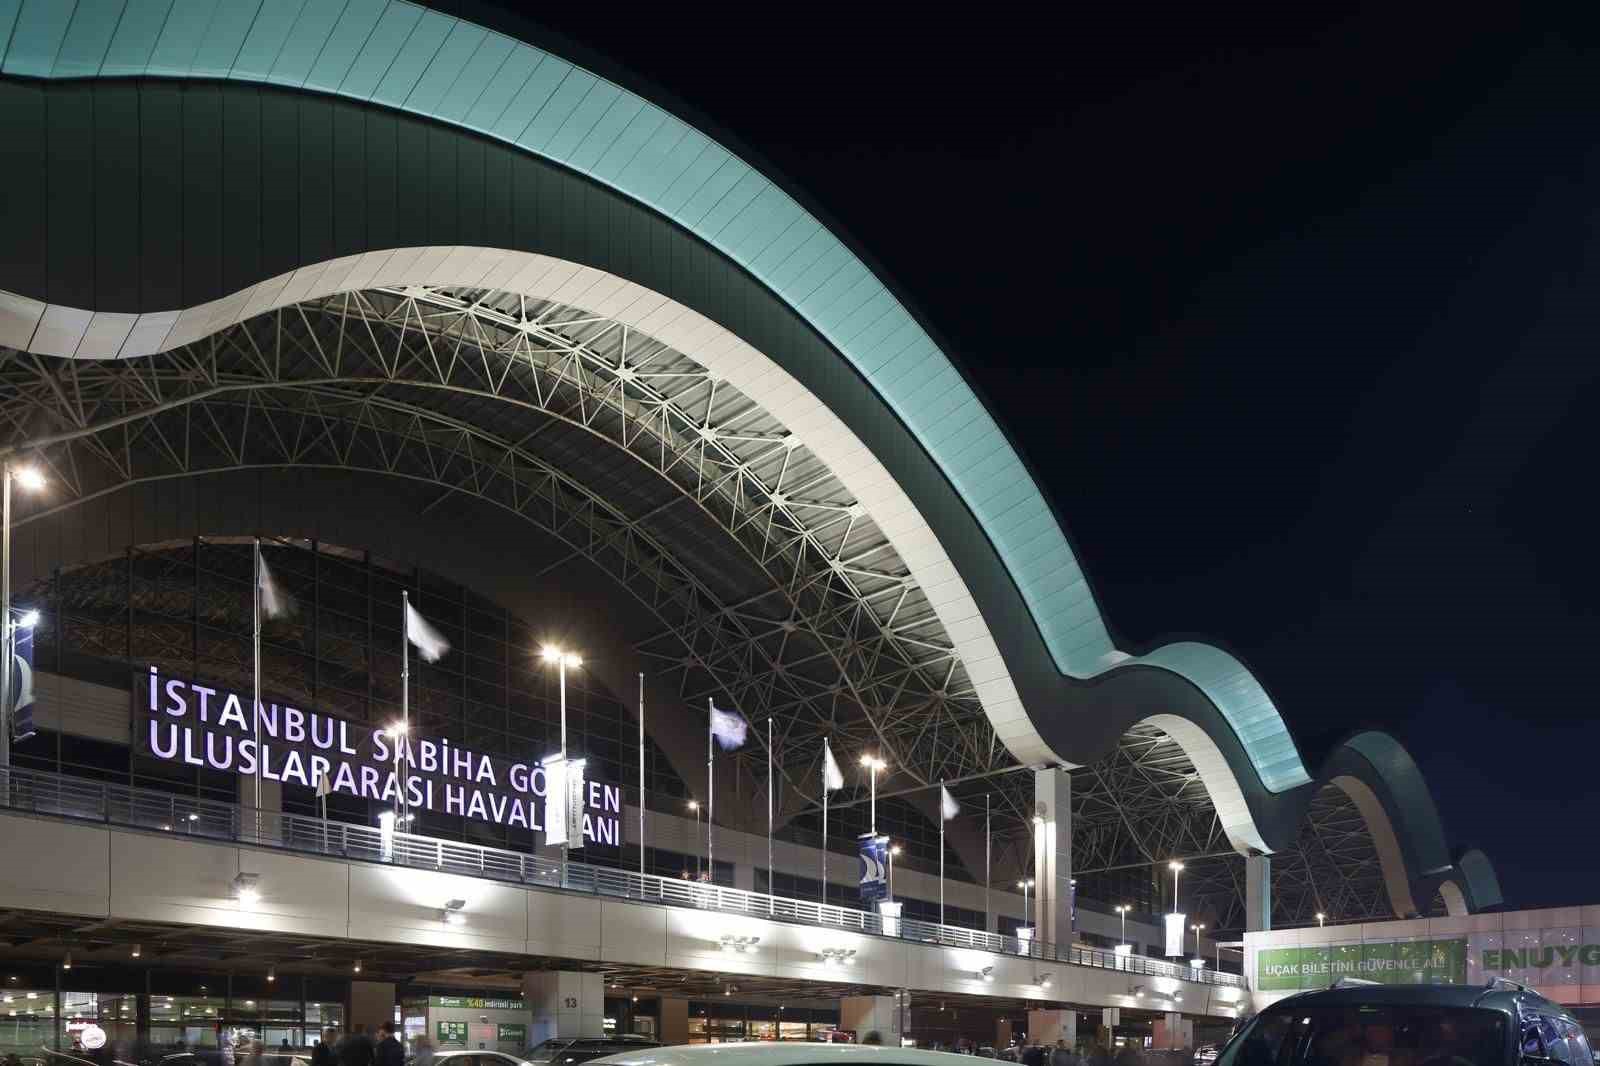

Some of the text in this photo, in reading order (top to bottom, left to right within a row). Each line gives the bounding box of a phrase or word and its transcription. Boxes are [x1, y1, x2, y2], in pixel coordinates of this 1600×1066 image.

[149, 666, 356, 755] İSTANBUL
[372, 729, 497, 786] SABİHA
[509, 761, 620, 813] GÖEN
[150, 719, 433, 810] ULUSLARARASI
[446, 783, 620, 846] HAVALİANI
[1302, 959, 1354, 975] BİLETİNİ
[1358, 957, 1421, 972] GÜVENLE
[564, 997, 577, 1009] 13
